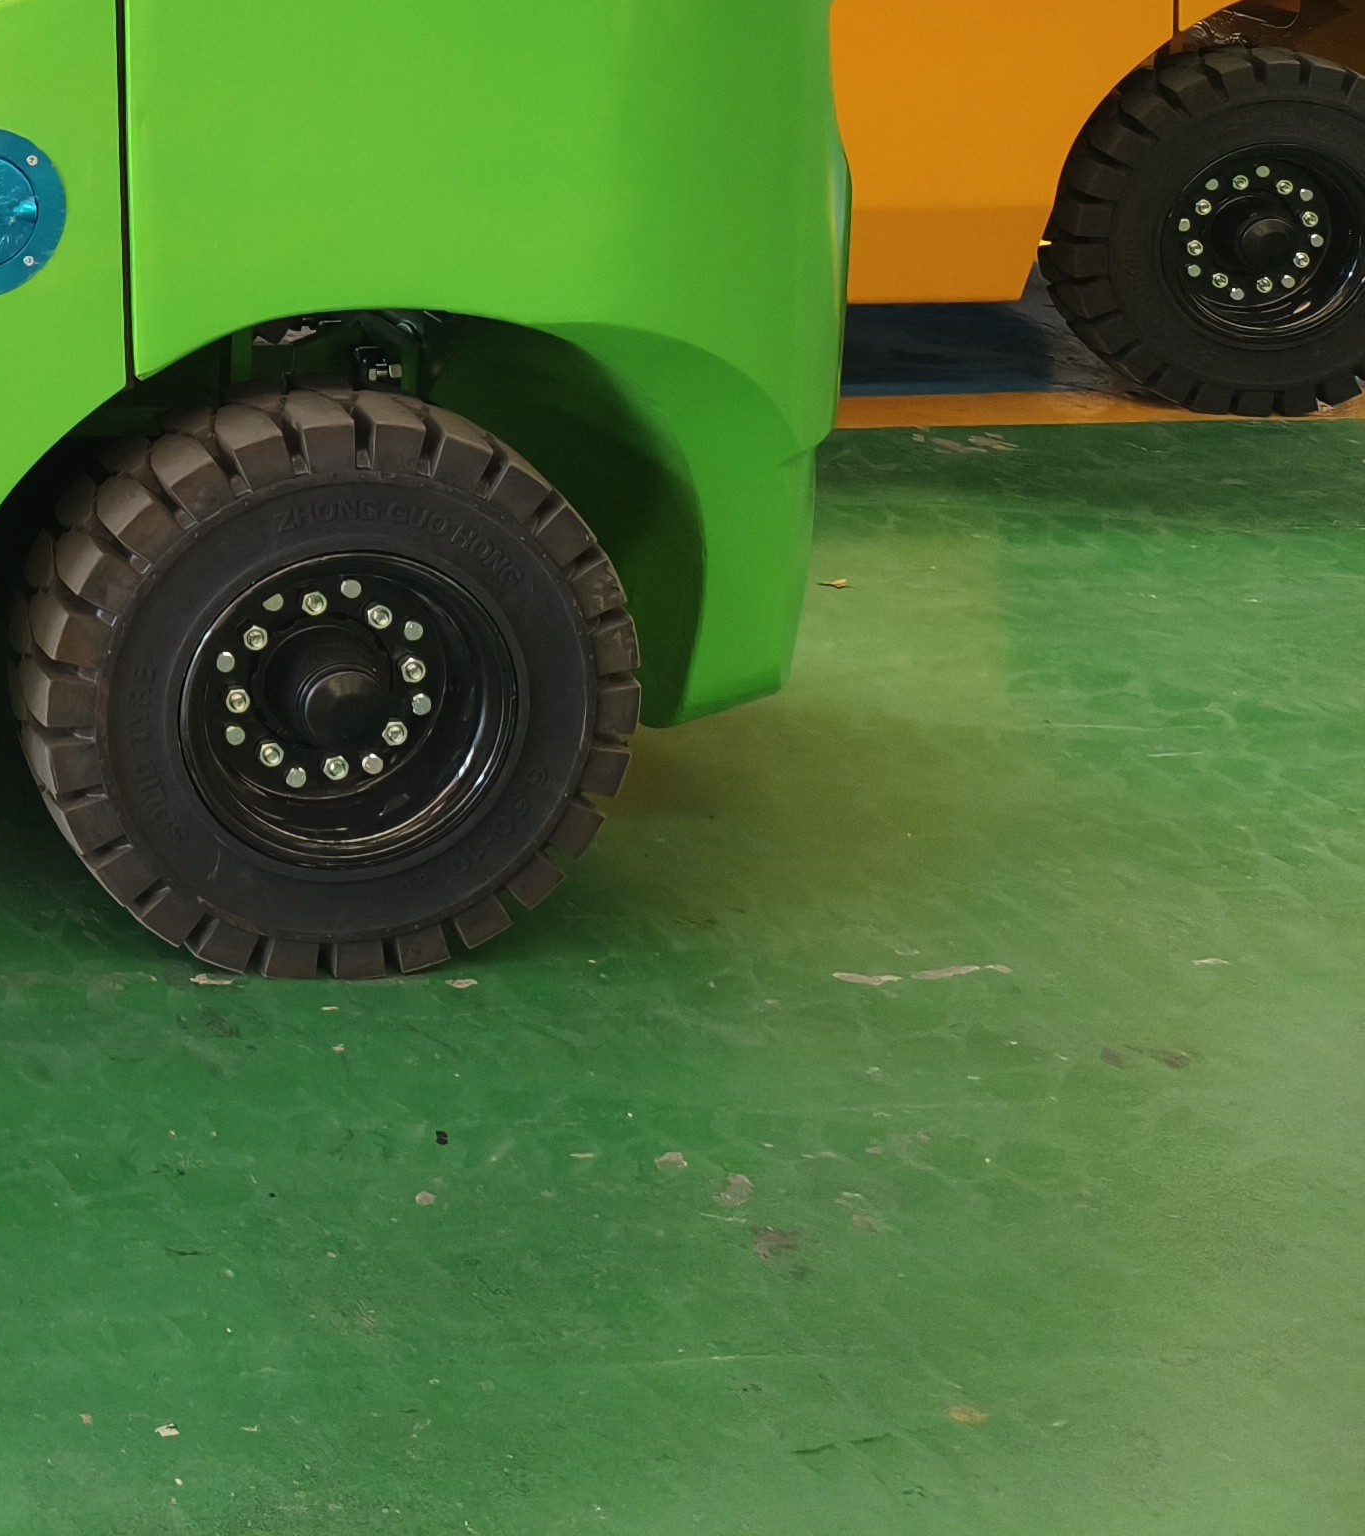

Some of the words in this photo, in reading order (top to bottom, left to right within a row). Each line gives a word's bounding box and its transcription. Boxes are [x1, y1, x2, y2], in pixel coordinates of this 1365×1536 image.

[273, 496, 379, 533] ZHONG
[386, 500, 450, 536] GUO
[450, 522, 526, 586] HONG
